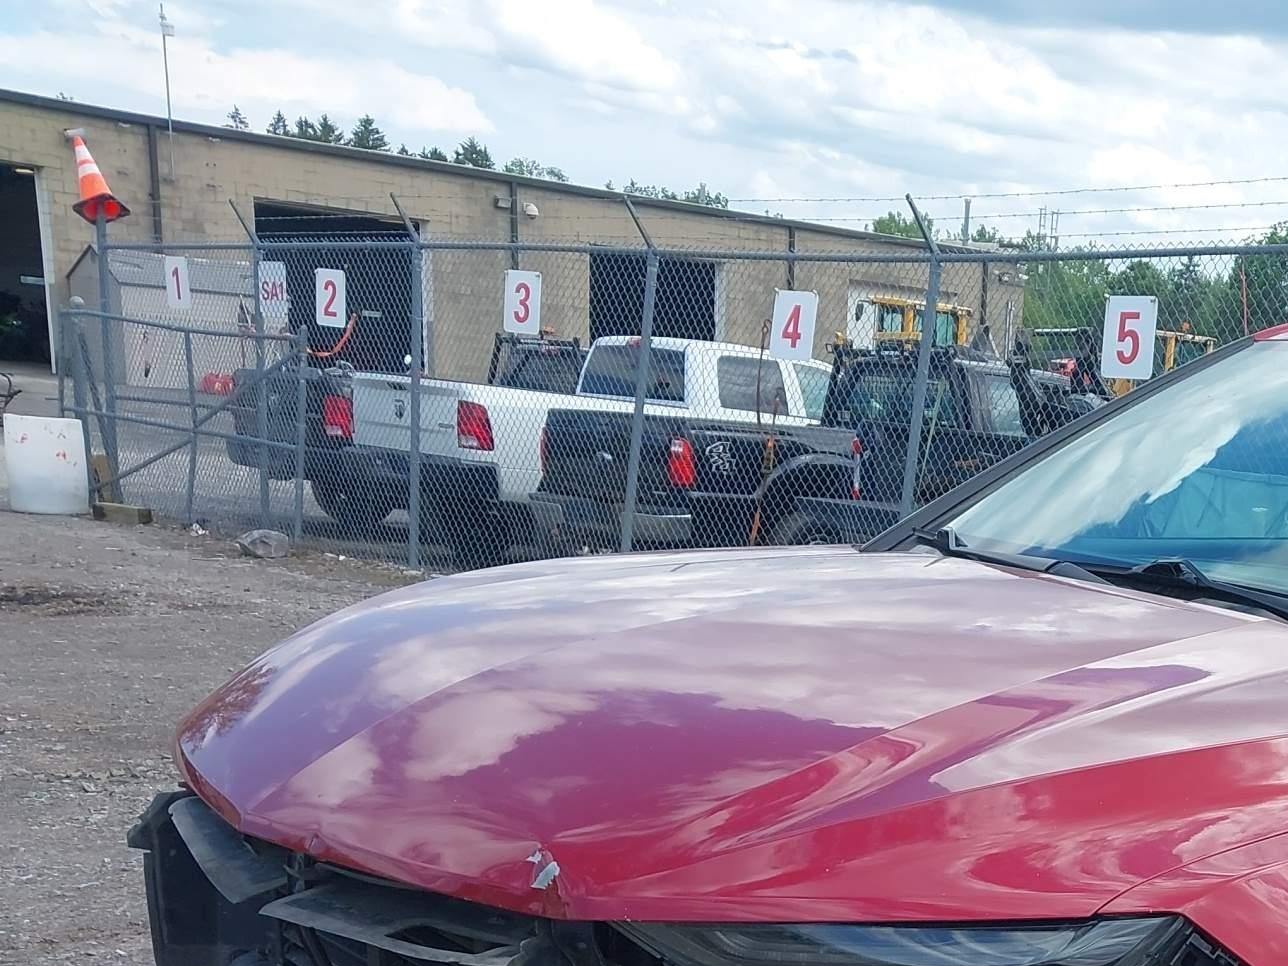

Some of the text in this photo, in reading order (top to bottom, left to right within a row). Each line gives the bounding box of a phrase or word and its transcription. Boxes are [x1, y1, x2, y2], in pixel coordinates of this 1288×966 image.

[172, 267, 181, 300] 1
[262, 280, 284, 301] SA1
[323, 280, 337, 317] 2
[514, 281, 531, 324] 3
[781, 303, 802, 349] 4
[1116, 310, 1142, 365] 5
